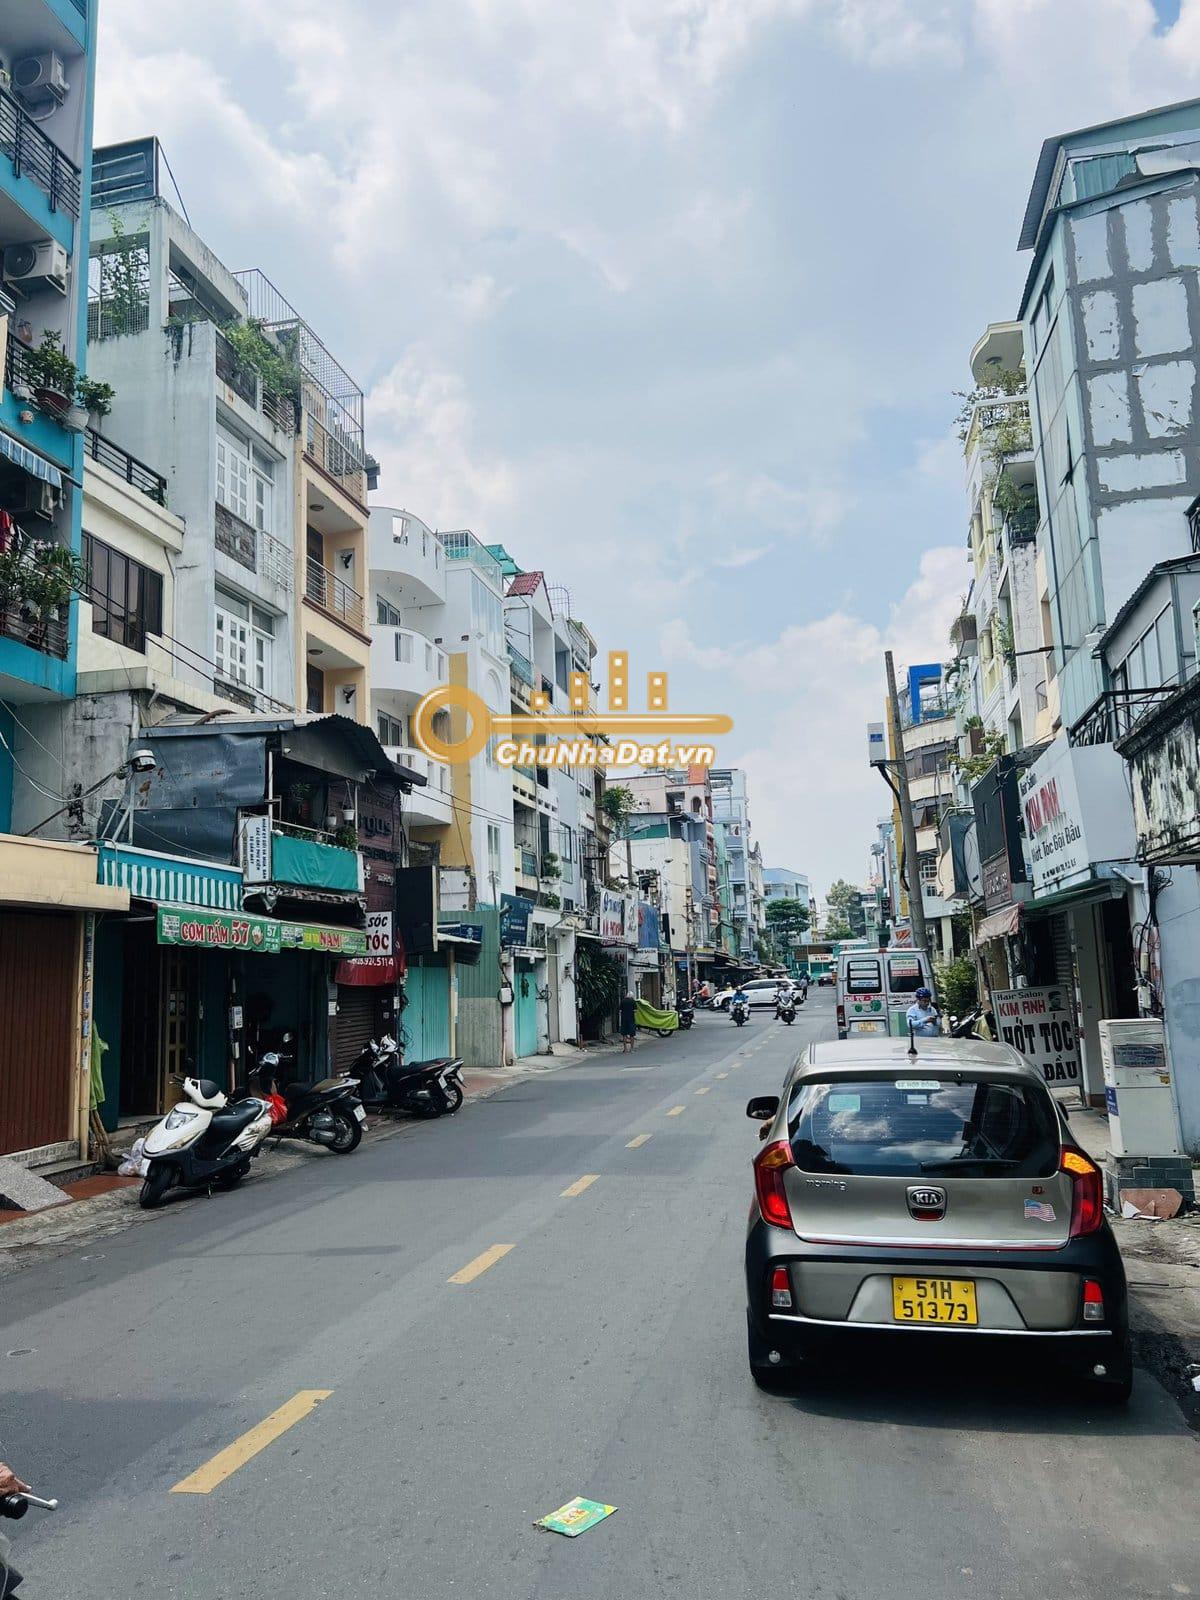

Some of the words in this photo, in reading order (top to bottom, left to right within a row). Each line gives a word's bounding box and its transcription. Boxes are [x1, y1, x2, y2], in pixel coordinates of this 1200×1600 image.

[267, 925, 276, 937] 57
[367, 914, 388, 928] SÓC
[181, 920, 205, 942] CƠM
[206, 918, 229, 944] TẤM
[231, 920, 250, 945] 57
[365, 930, 389, 951] TÓC
[996, 993, 1017, 1001] Hair
[1018, 991, 1044, 999] Salon
[999, 1002, 1020, 1017] KIM
[1022, 1000, 1046, 1014] ANH
[1002, 1016, 1036, 1055] HỚT
[1039, 1013, 1074, 1053] TÓC
[1043, 1055, 1078, 1080] ĐẦU
[915, 1192, 938, 1204] KIA
[916, 1280, 952, 1300] 51H
[902, 1300, 969, 1321] 513.73
